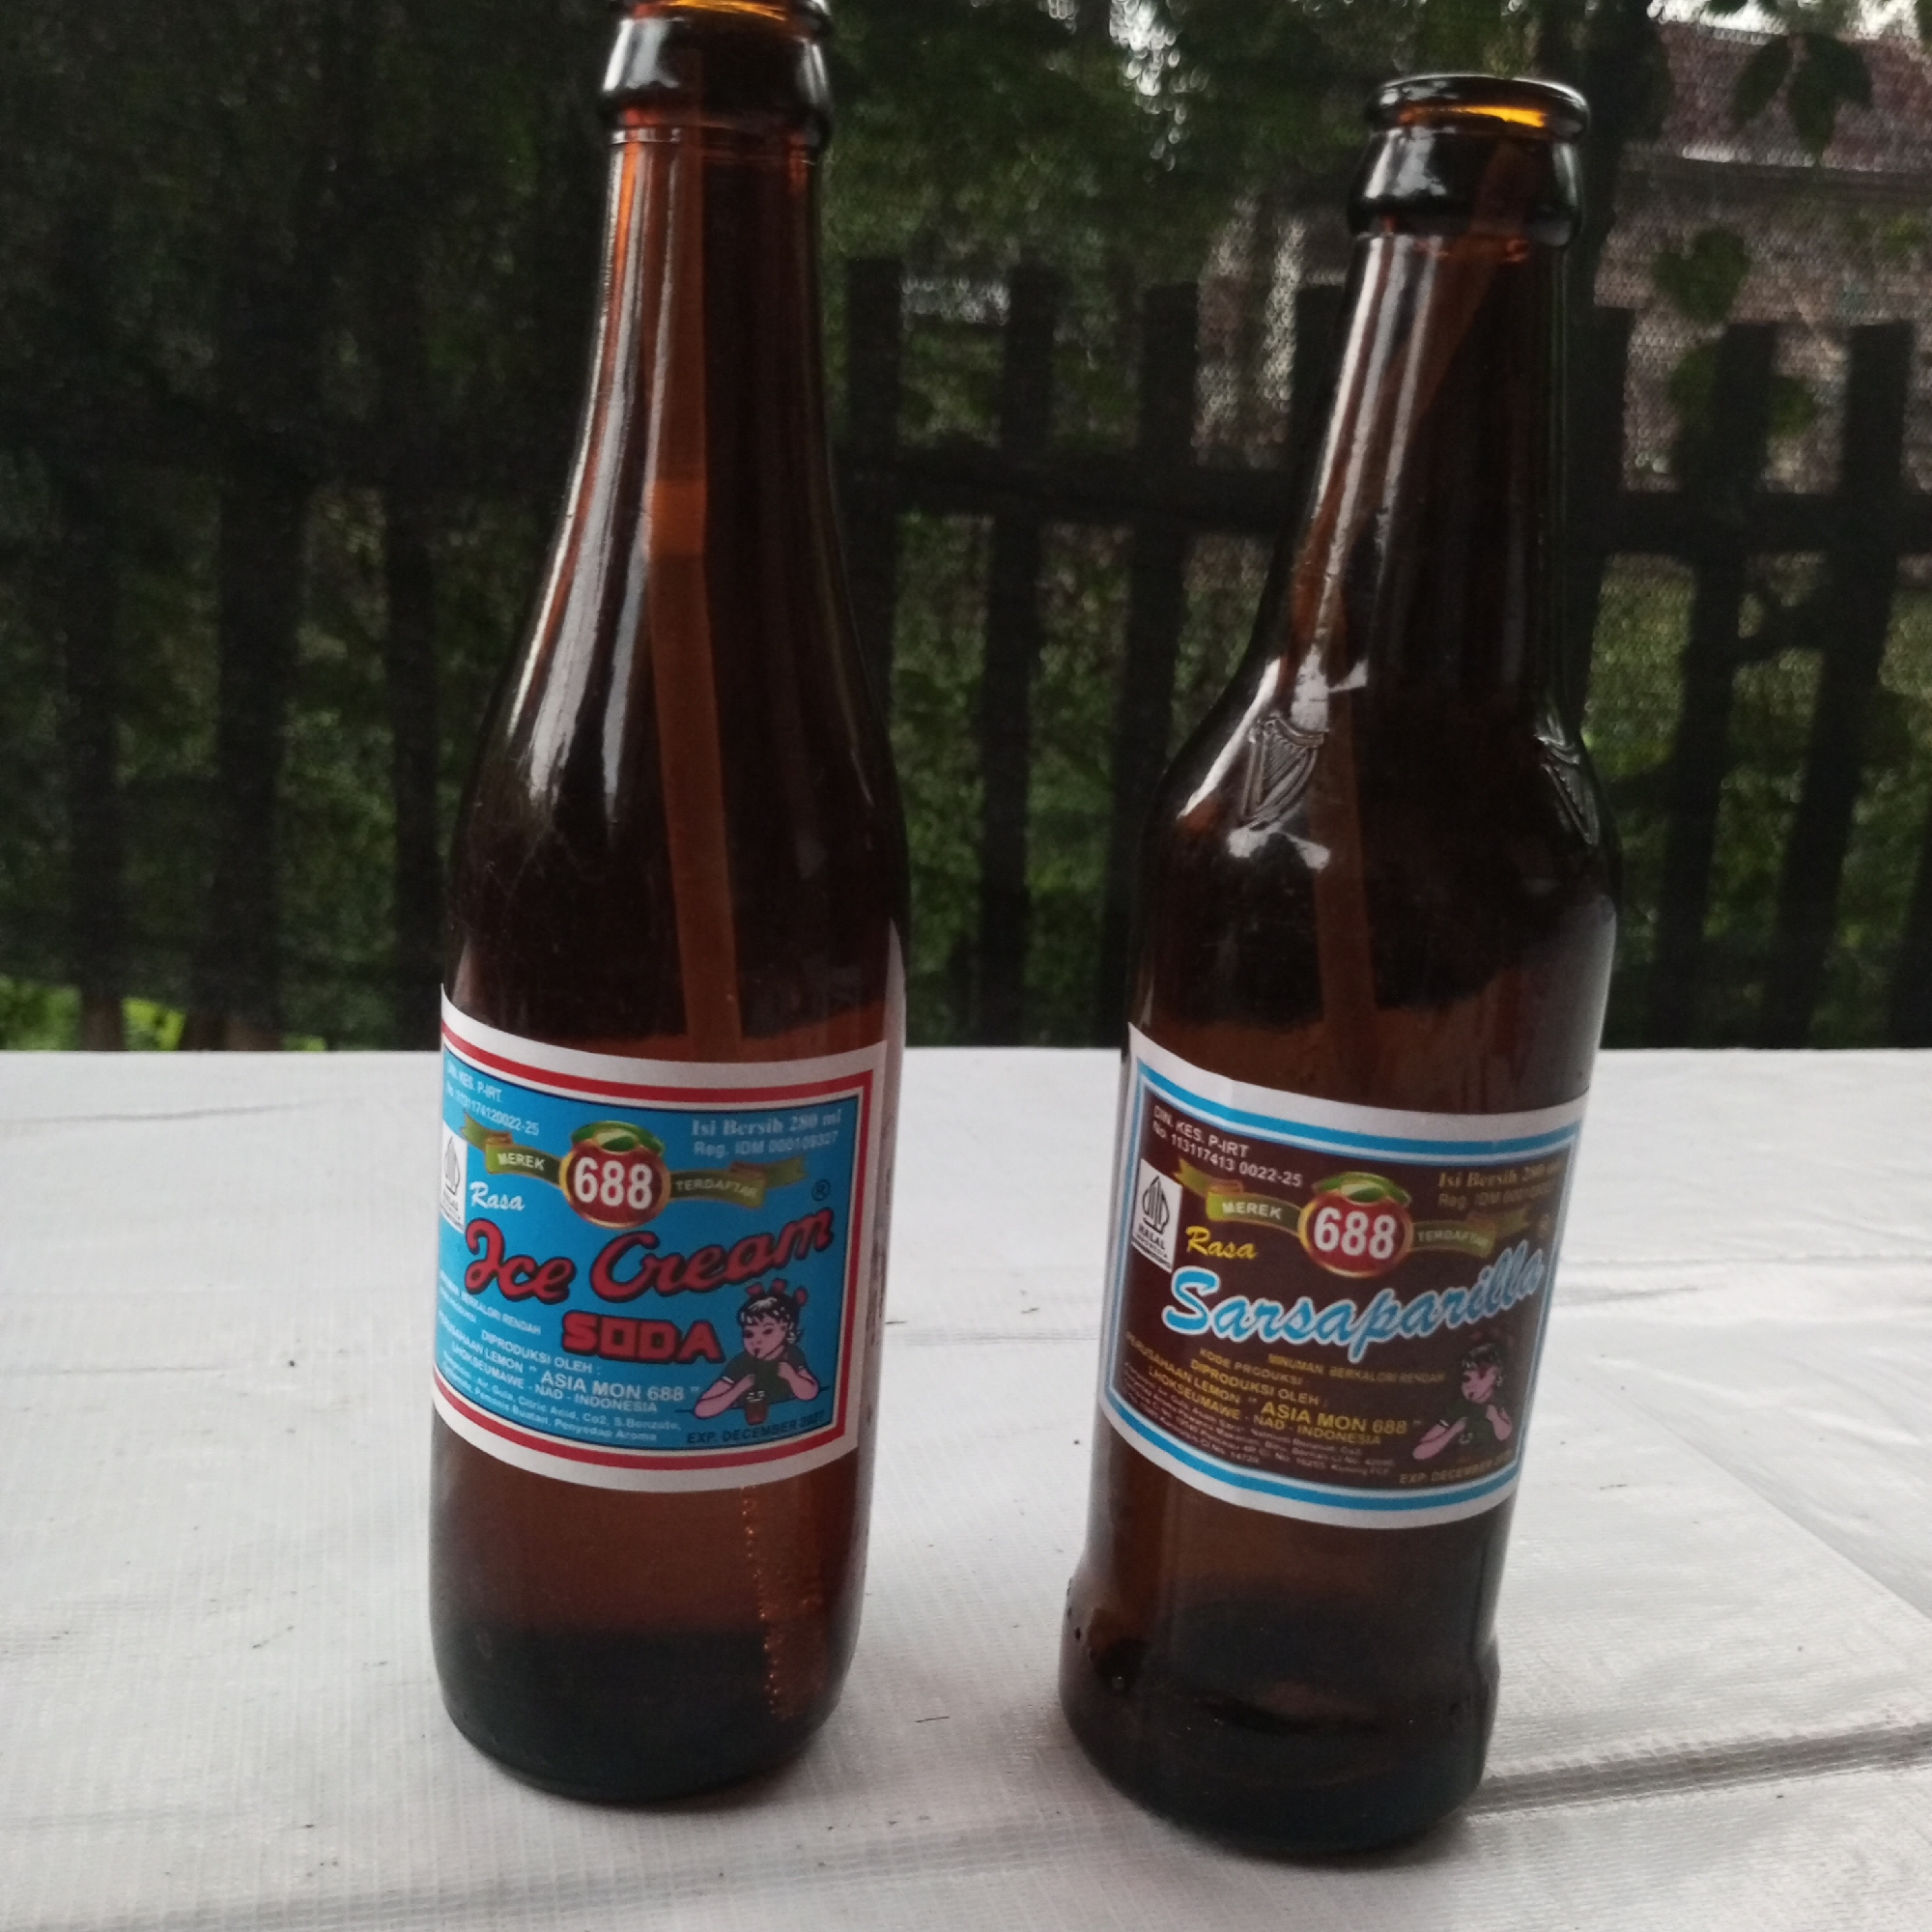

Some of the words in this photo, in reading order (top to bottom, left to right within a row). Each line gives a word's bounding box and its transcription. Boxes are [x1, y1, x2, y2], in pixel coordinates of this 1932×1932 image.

[1176, 1120, 1205, 1144] KES.
[1208, 1134, 1250, 1158] P-IRT
[497, 1152, 547, 1171] MEREK
[574, 1156, 653, 1209] 688
[1238, 1160, 1304, 1188] 0022-25
[469, 1180, 526, 1211] Rasa
[1185, 1225, 1257, 1260] Rasa
[1222, 1201, 1283, 1220] MEREK
[1314, 1208, 1397, 1260] 688
[465, 1217, 577, 1303] Ice
[590, 1207, 835, 1302] Cream
[1162, 1239, 1545, 1363] Sarsaparilla
[561, 1310, 725, 1364] SODA
[485, 1348, 524, 1373] LEMON
[541, 1369, 586, 1394] ASIA
[592, 1379, 641, 1400] MON
[646, 1385, 685, 1402] 688
[554, 1356, 593, 1374] OLEH
[1190, 1358, 1275, 1396] DIPRODUKSI
[1278, 1387, 1320, 1406] OLEH
[1200, 1348, 1232, 1369] KODE
[1235, 1361, 1302, 1385] PRODUKSI
[534, 1382, 563, 1401] NAD
[574, 1393, 658, 1412] INDONESIA
[1193, 1377, 1240, 1405] LEMON
[1261, 1401, 1312, 1425] ASIA
[1317, 1412, 1367, 1432] MON
[1372, 1419, 1408, 1435] 688
[723, 1419, 798, 1441] DECEMBER
[1253, 1413, 1286, 1431] NAD
[1296, 1424, 1381, 1445] INDONESIA
